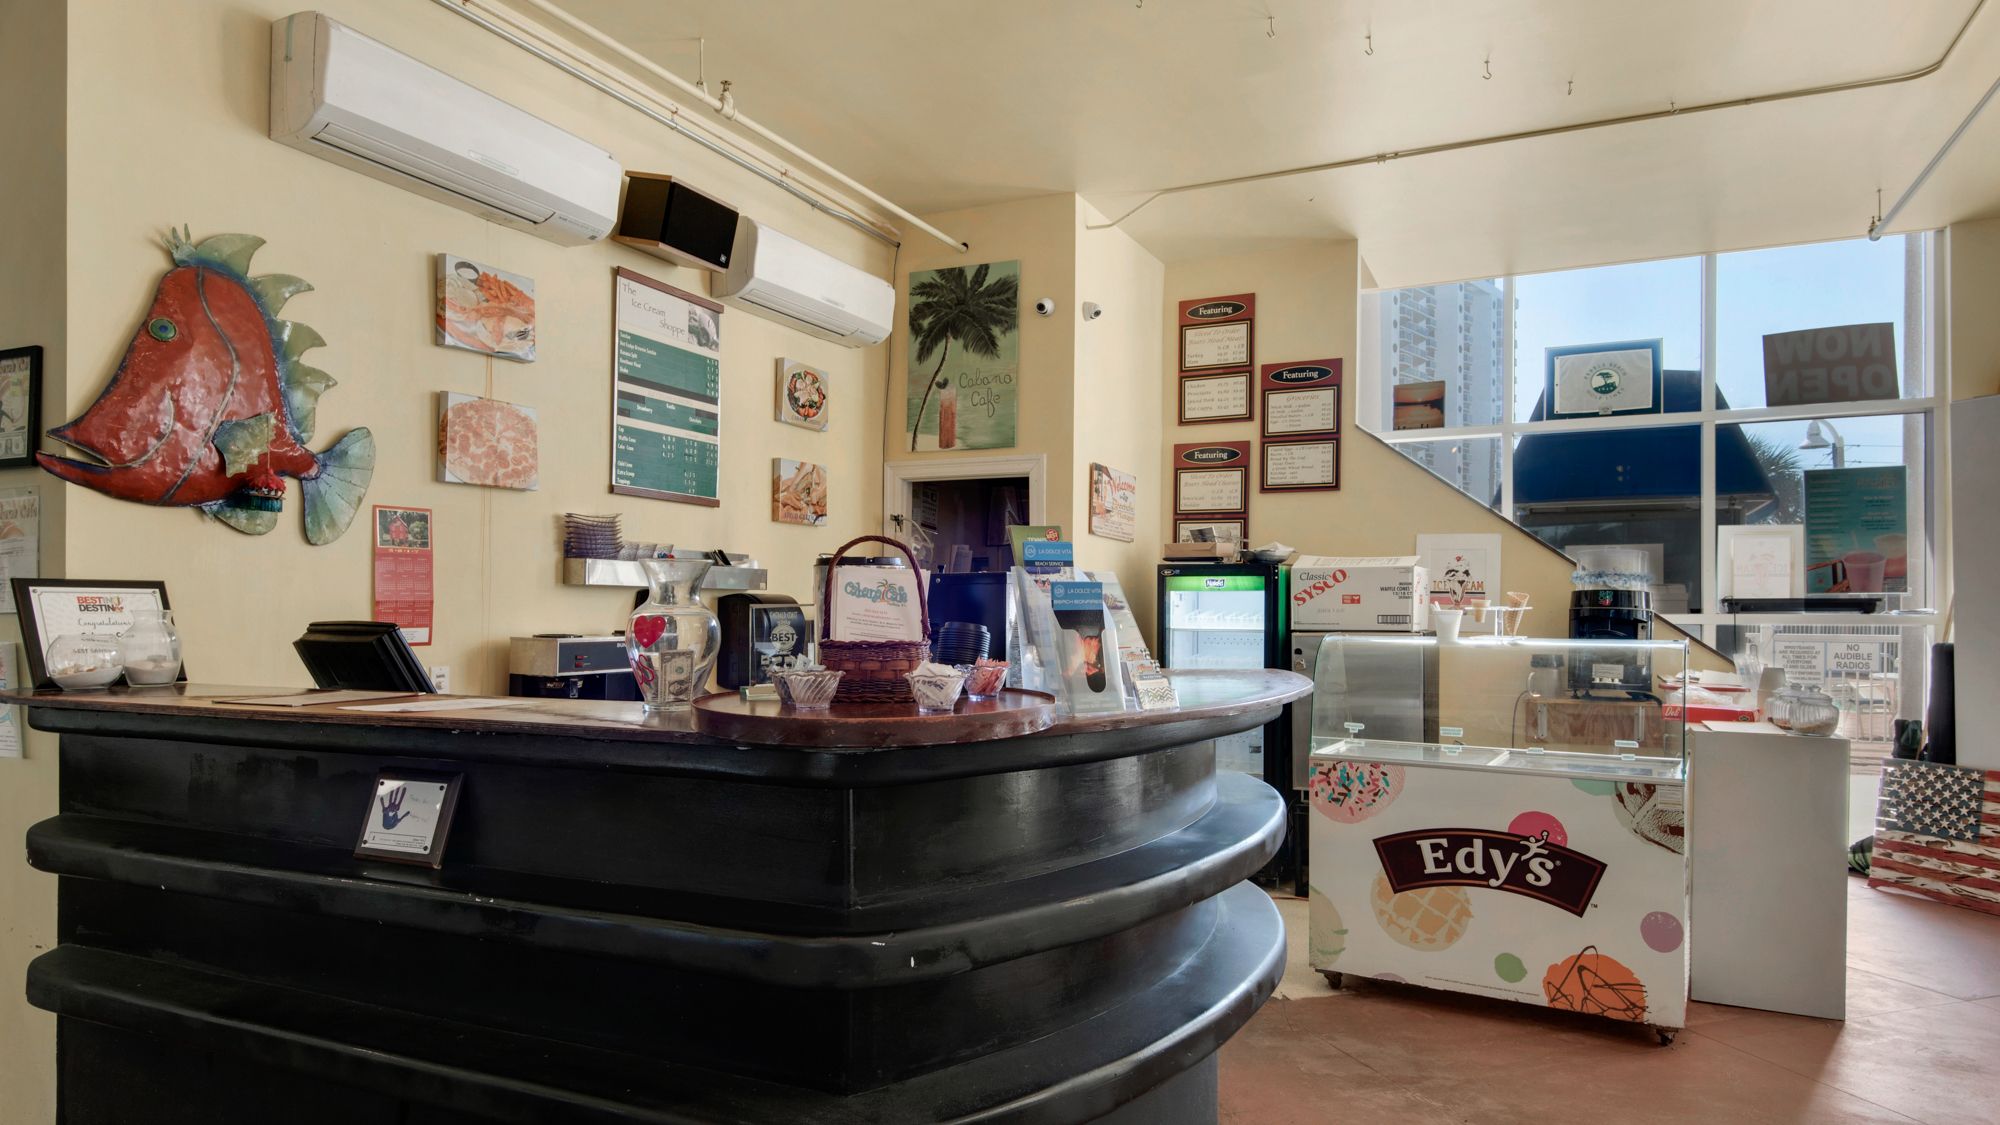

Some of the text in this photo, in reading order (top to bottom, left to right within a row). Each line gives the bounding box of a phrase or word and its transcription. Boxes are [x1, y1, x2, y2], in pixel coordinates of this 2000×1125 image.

[622, 281, 637, 296] The
[631, 298, 666, 317] Ice Cream
[1199, 305, 1233, 316] Featuring
[659, 319, 686, 337] Shoppe
[959, 368, 1013, 389] Cabana
[1282, 370, 1319, 379] Featuring
[970, 388, 1001, 418] Cafe
[1194, 451, 1228, 460] Featuring
[1300, 572, 1329, 581] Classic
[1293, 569, 1347, 606] SYSCO
[772, 633, 796, 642] BEST
[1834, 652, 1872, 660] AUDIBLE
[1836, 662, 1871, 670] RADIOS
[1664, 706, 1680, 717] Deli
[1416, 837, 1554, 888] Edy's
